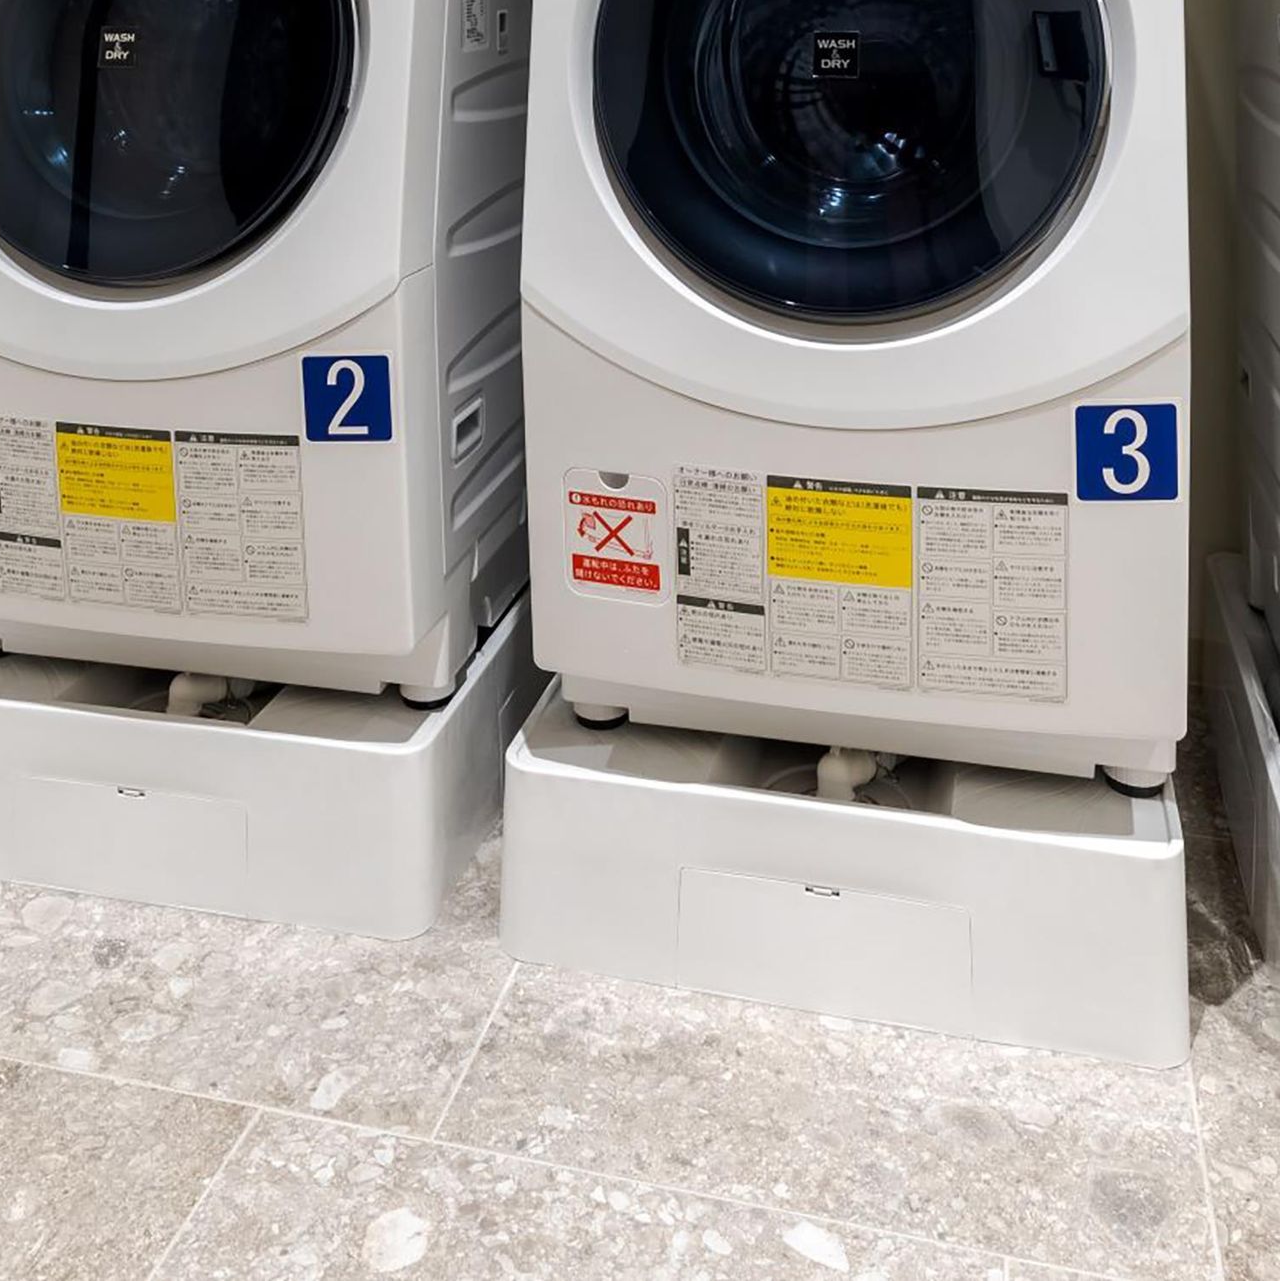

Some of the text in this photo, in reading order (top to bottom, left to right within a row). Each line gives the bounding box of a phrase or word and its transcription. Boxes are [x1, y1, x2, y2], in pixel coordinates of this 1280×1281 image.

[104, 33, 135, 42] WASH
[816, 39, 856, 49] WASH
[105, 50, 129, 60] DRY
[820, 58, 851, 69] DRY
[327, 359, 369, 435] 2
[1102, 408, 1151, 495] 3
